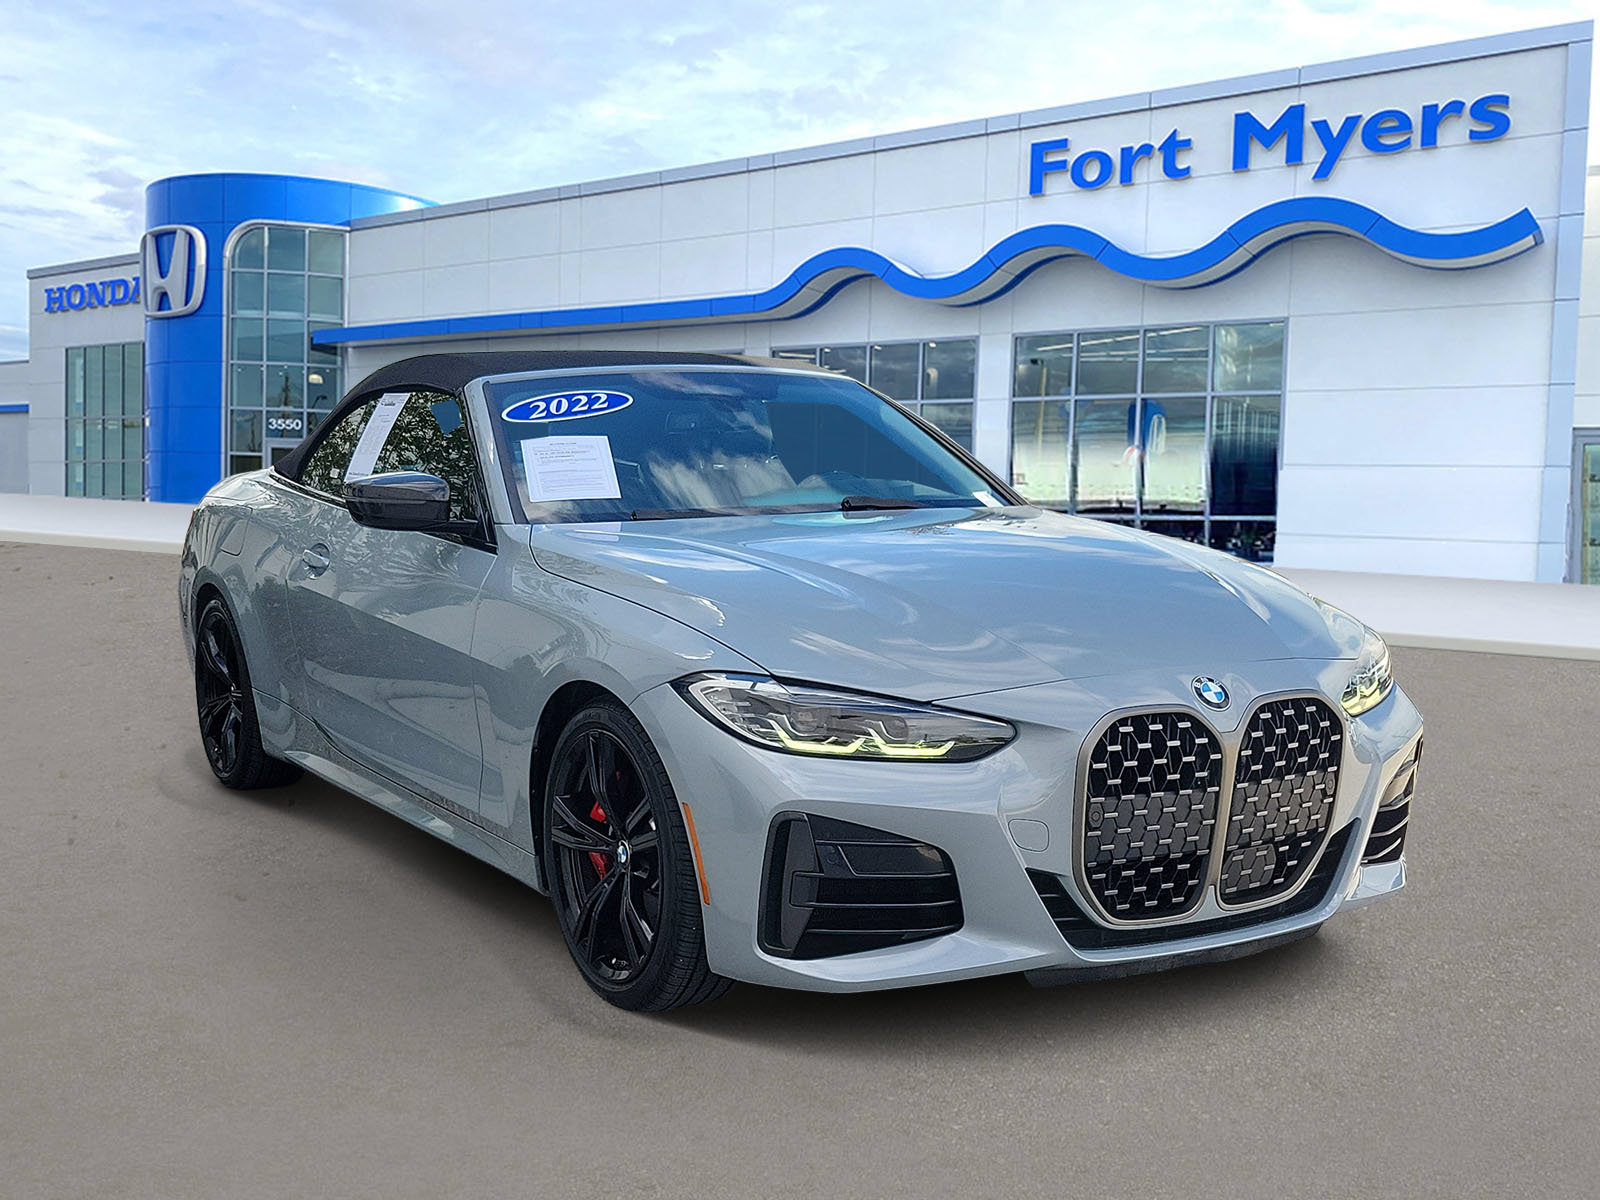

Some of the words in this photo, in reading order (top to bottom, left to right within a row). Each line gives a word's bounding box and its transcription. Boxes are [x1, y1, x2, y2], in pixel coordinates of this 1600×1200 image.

[1028, 128, 1193, 198] Fort
[1232, 94, 1512, 182] Myers
[529, 393, 609, 419] 2022
[268, 418, 302, 430] 3550
